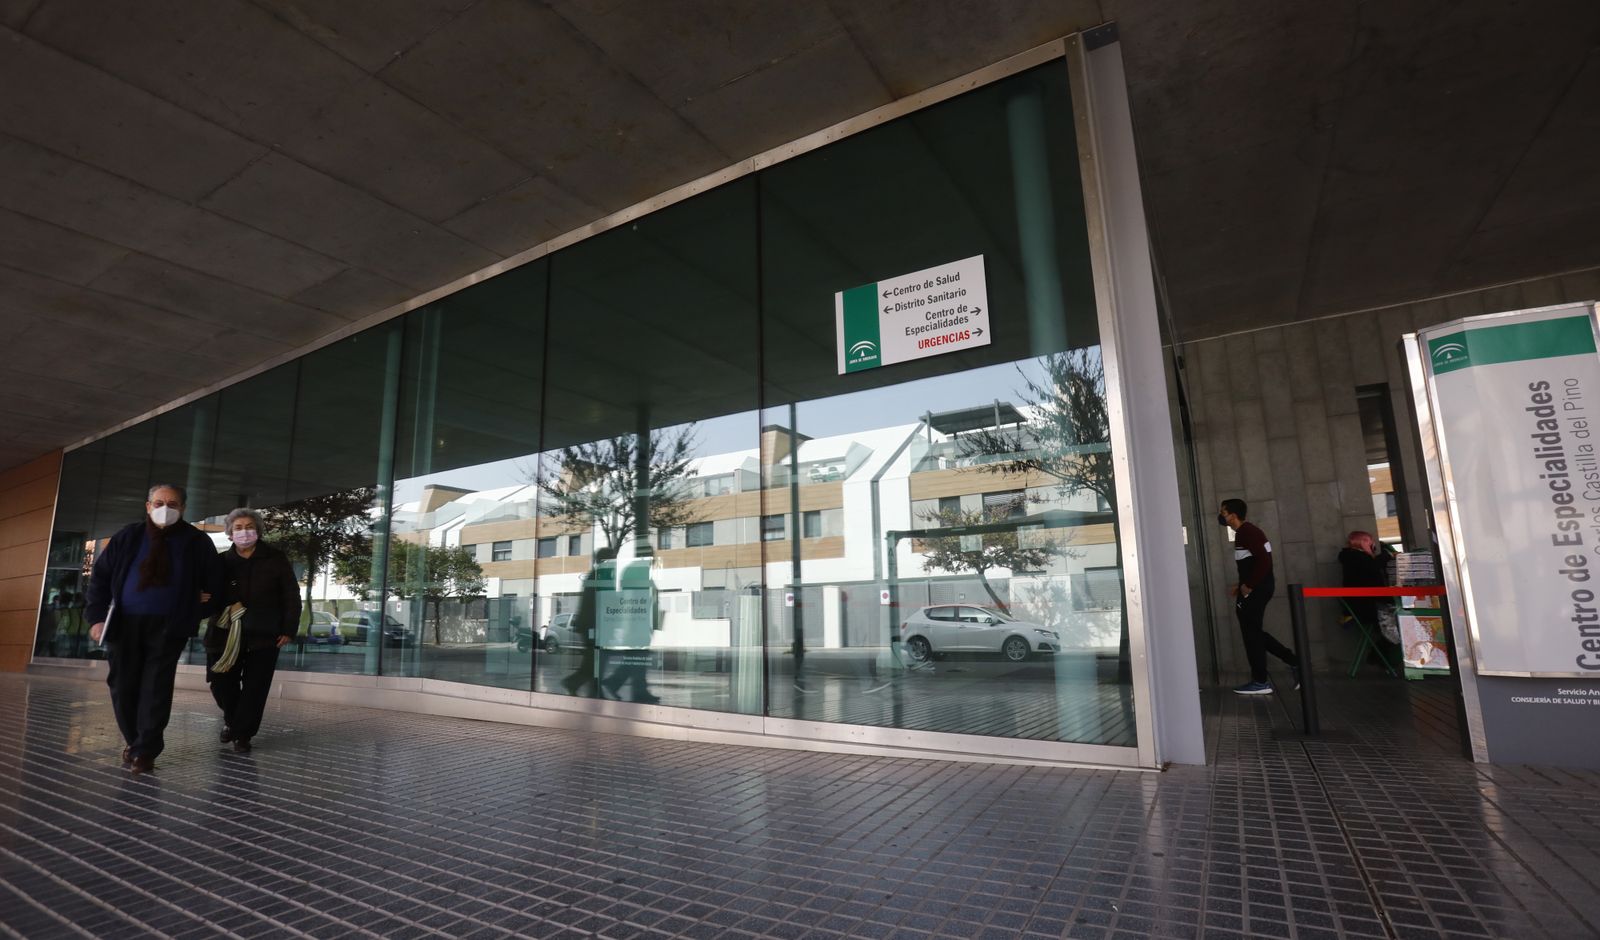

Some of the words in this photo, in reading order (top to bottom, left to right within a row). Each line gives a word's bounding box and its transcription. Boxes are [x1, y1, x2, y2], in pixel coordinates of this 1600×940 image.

[893, 283, 921, 296] Centro
[923, 280, 934, 289] de
[936, 272, 960, 286] Salud
[895, 299, 925, 312] Distrito
[928, 288, 967, 304] Sanitario
[925, 308, 955, 321] Centro
[957, 304, 968, 315] de
[905, 315, 969, 337] Especialidades
[918, 330, 970, 350] URGENCIAS
[1562, 378, 1585, 411] Pino
[1566, 416, 1591, 439] del
[1525, 380, 1585, 546] Especialidades
[1574, 443, 1600, 501] Castilla
[1558, 554, 1591, 583] de
[1571, 589, 1600, 671] Centro
[1557, 688, 1587, 696] Servicio
